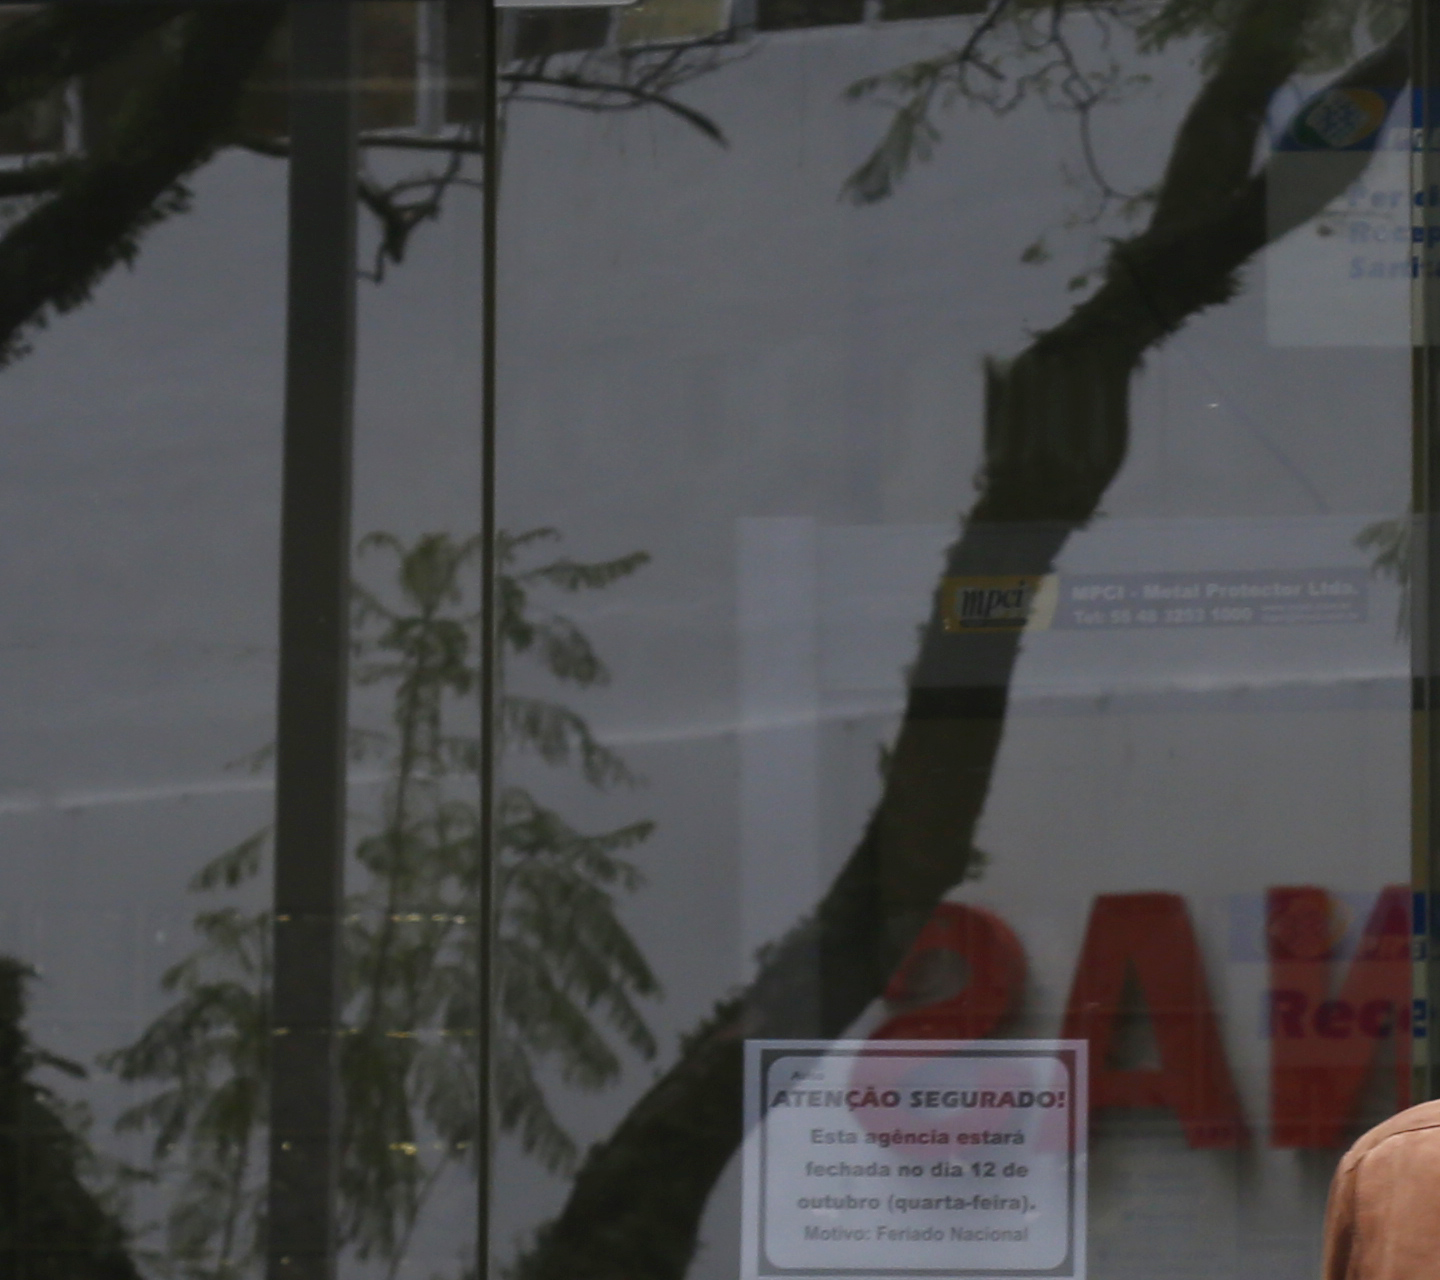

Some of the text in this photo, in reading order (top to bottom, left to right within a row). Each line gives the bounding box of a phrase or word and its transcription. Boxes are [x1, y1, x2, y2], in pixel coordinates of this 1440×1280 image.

[769, 1087, 1066, 1112] ATENÇÃO SEGURADO!
[810, 1128, 1025, 1148] Esta agência estará
[805, 1161, 1028, 1178] fechada no dia 12 de
[797, 1193, 1036, 1213] outubro (quarta-feira).
[876, 1225, 944, 1242] Feriado
[950, 1225, 1029, 1242] Nacional
